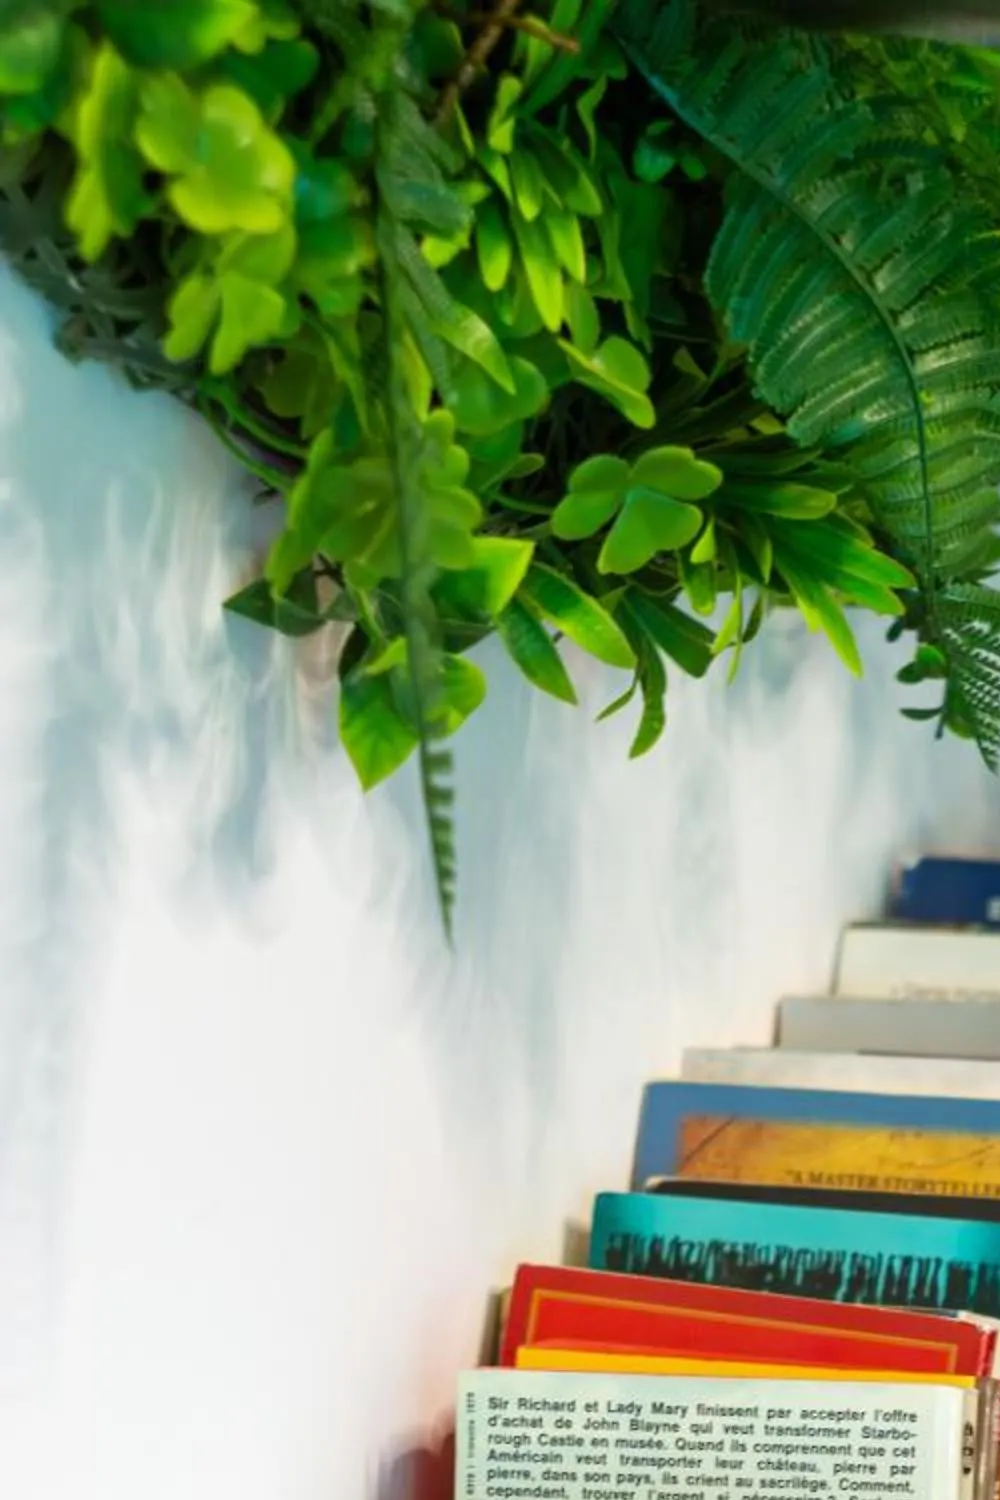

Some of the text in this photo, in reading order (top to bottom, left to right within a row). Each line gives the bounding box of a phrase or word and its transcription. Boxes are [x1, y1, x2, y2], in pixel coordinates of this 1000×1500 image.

[487, 1396, 510, 1411] Sir
[516, 1397, 577, 1413] Richard
[583, 1398, 599, 1413] et
[606, 1399, 644, 1418] Lady
[650, 1400, 689, 1419] Mary
[695, 1402, 759, 1418] finissent
[765, 1407, 793, 1422] par
[799, 1404, 867, 1424] accepter
[553, 1415, 574, 1430] de
[582, 1416, 620, 1431] John
[628, 1417, 681, 1437] Blayne
[688, 1419, 714, 1438] qui
[722, 1420, 755, 1435] veut
[763, 1421, 852, 1438] transformer
[860, 1424, 918, 1440] Starbo-
[487, 1431, 532, 1450] rough
[536, 1432, 585, 1448] Castle
[589, 1437, 610, 1449] en
[674, 1436, 725, 1453] Quand
[730, 1438, 748, 1453] ils
[752, 1438, 852, 1459] comprennent
[857, 1444, 887, 1460] que
[892, 1442, 916, 1457] cet
[486, 1447, 563, 1464] Américain
[575, 1450, 607, 1465] veut
[619, 1451, 703, 1471] transporter
[714, 1454, 745, 1469] leur
[832, 1457, 878, 1476] pierre
[889, 1461, 917, 1477] par
[540, 1466, 579, 1482] dans
[583, 1470, 611, 1483] son
[661, 1470, 680, 1485] ils
[684, 1470, 730, 1486] crient
[734, 1475, 754, 1487] au
[581, 1485, 636, 1500] trouver
